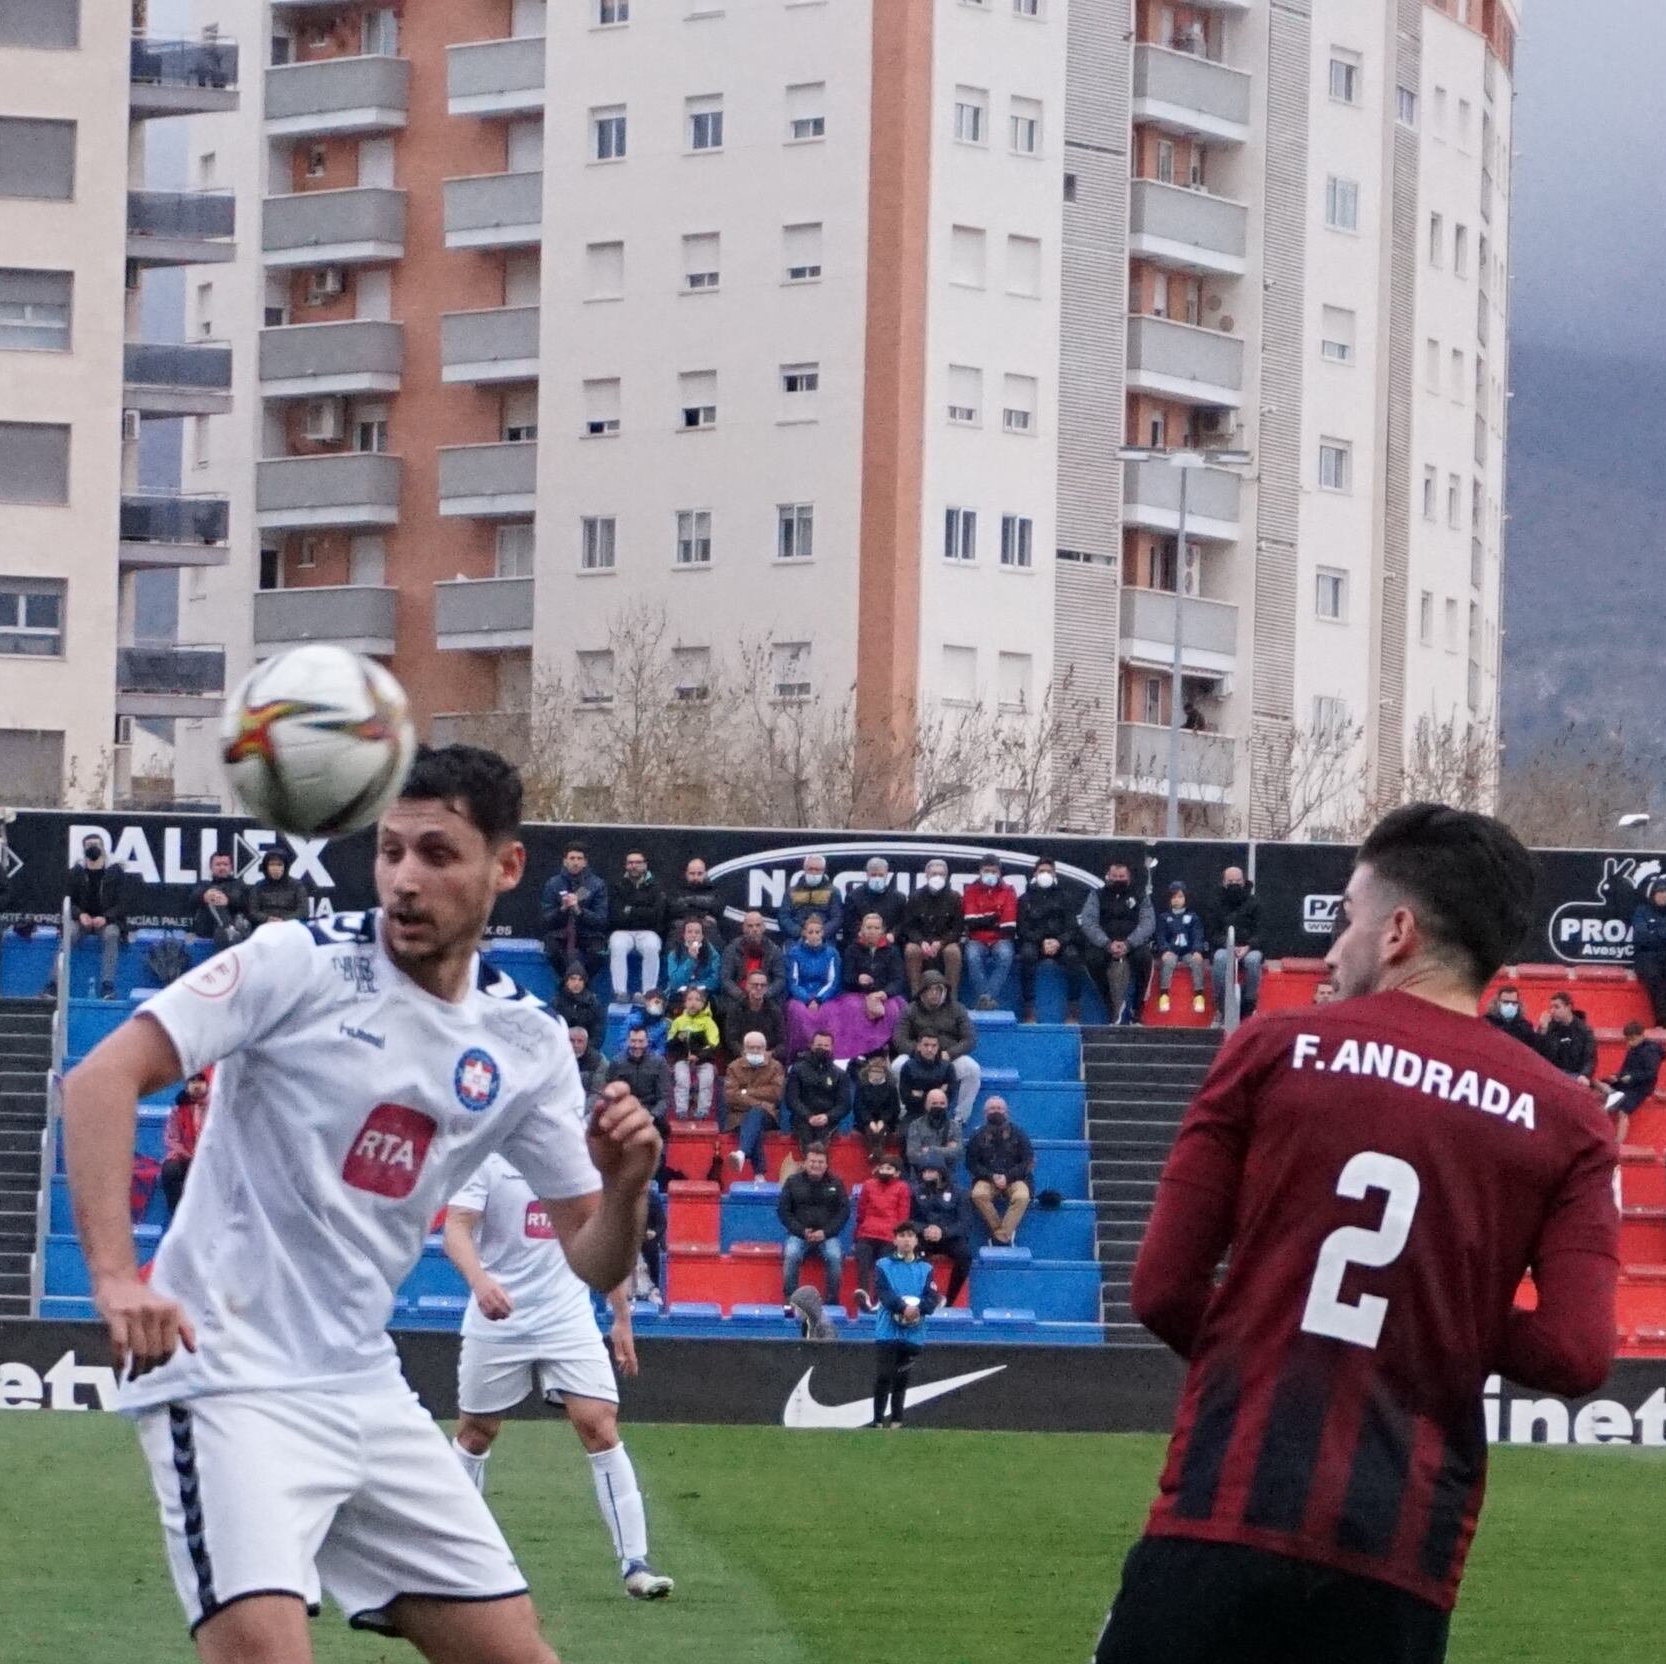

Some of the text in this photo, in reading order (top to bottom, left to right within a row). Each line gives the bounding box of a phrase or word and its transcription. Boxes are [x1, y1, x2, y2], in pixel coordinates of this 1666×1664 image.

[69, 824, 336, 887] PALLEX
[355, 1129, 415, 1171] RTA
[1300, 1150, 1421, 1350] 2
